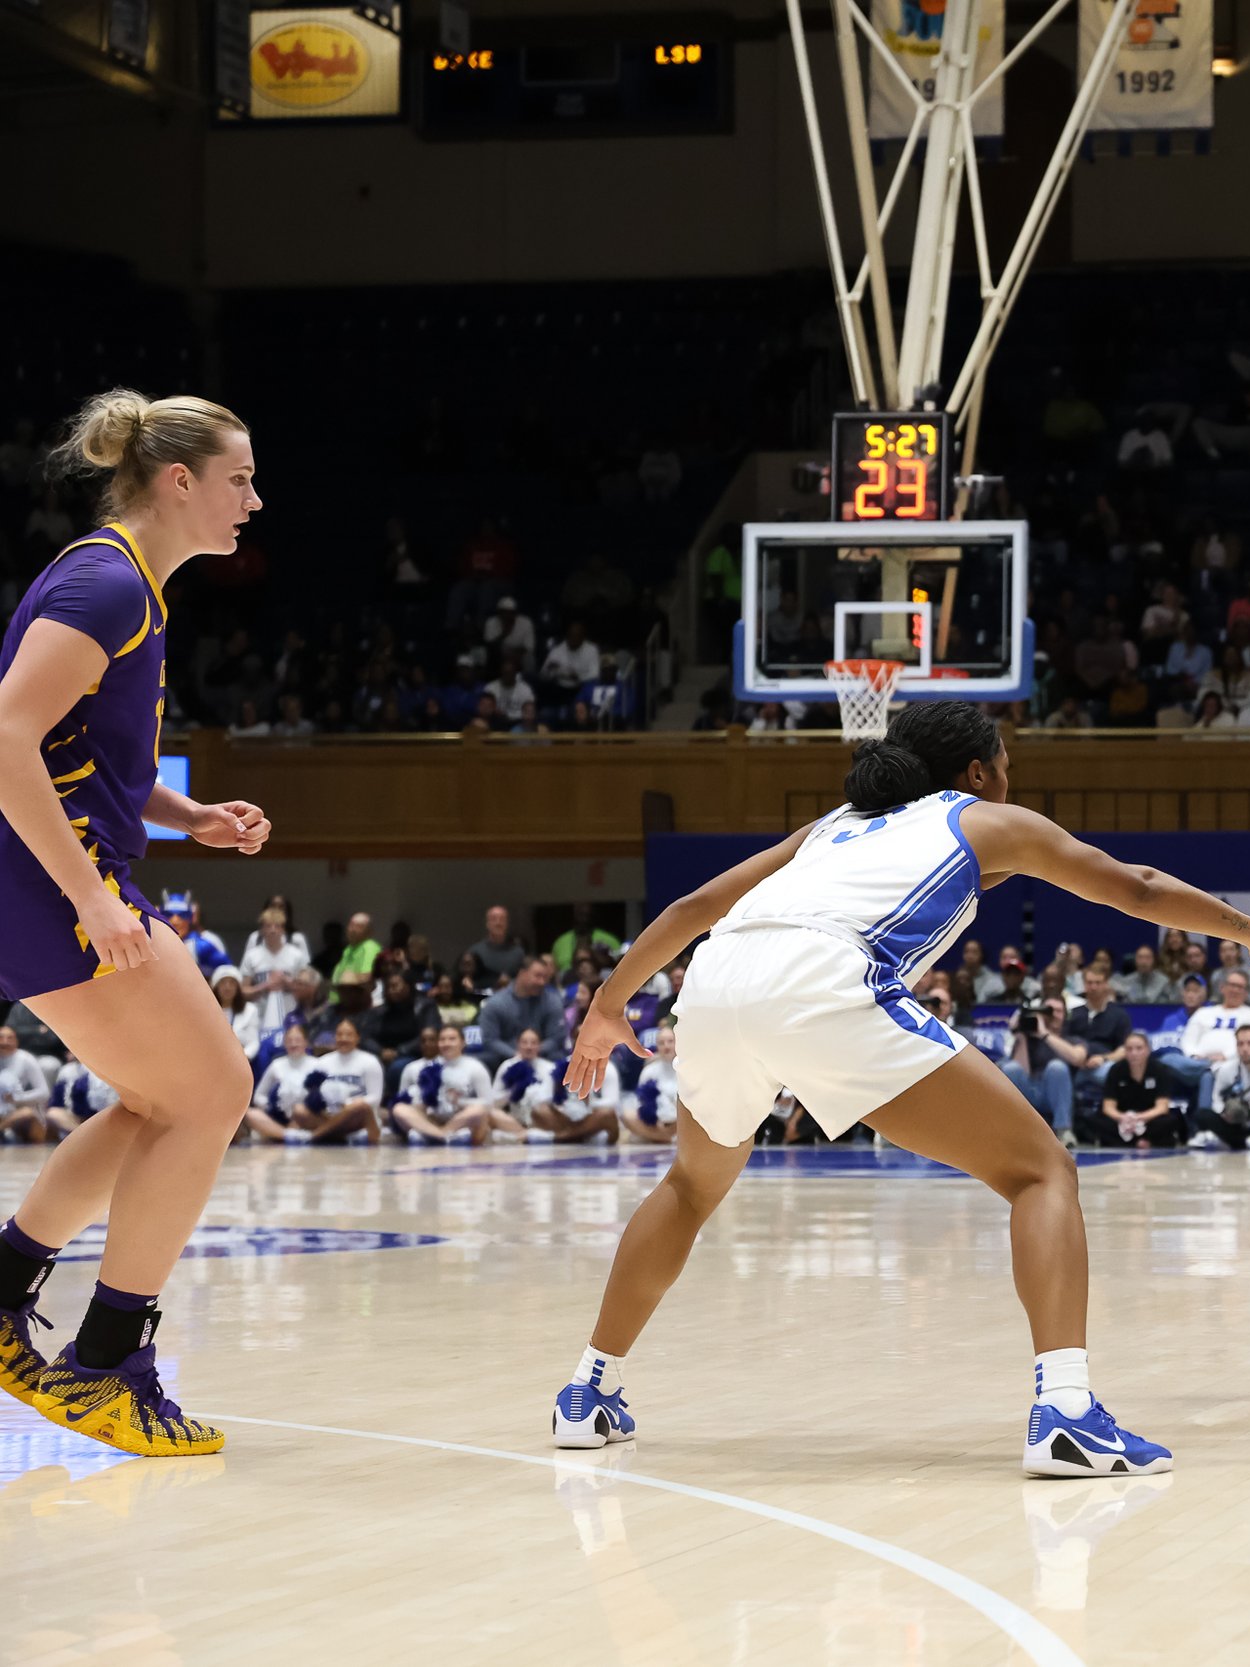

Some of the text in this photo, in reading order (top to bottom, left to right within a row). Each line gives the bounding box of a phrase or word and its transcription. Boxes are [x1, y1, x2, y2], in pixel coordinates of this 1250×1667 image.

[655, 44, 701, 64] LSU
[1116, 69, 1176, 94] 1992
[865, 424, 937, 459] 5:27
[854, 459, 927, 518] 23
